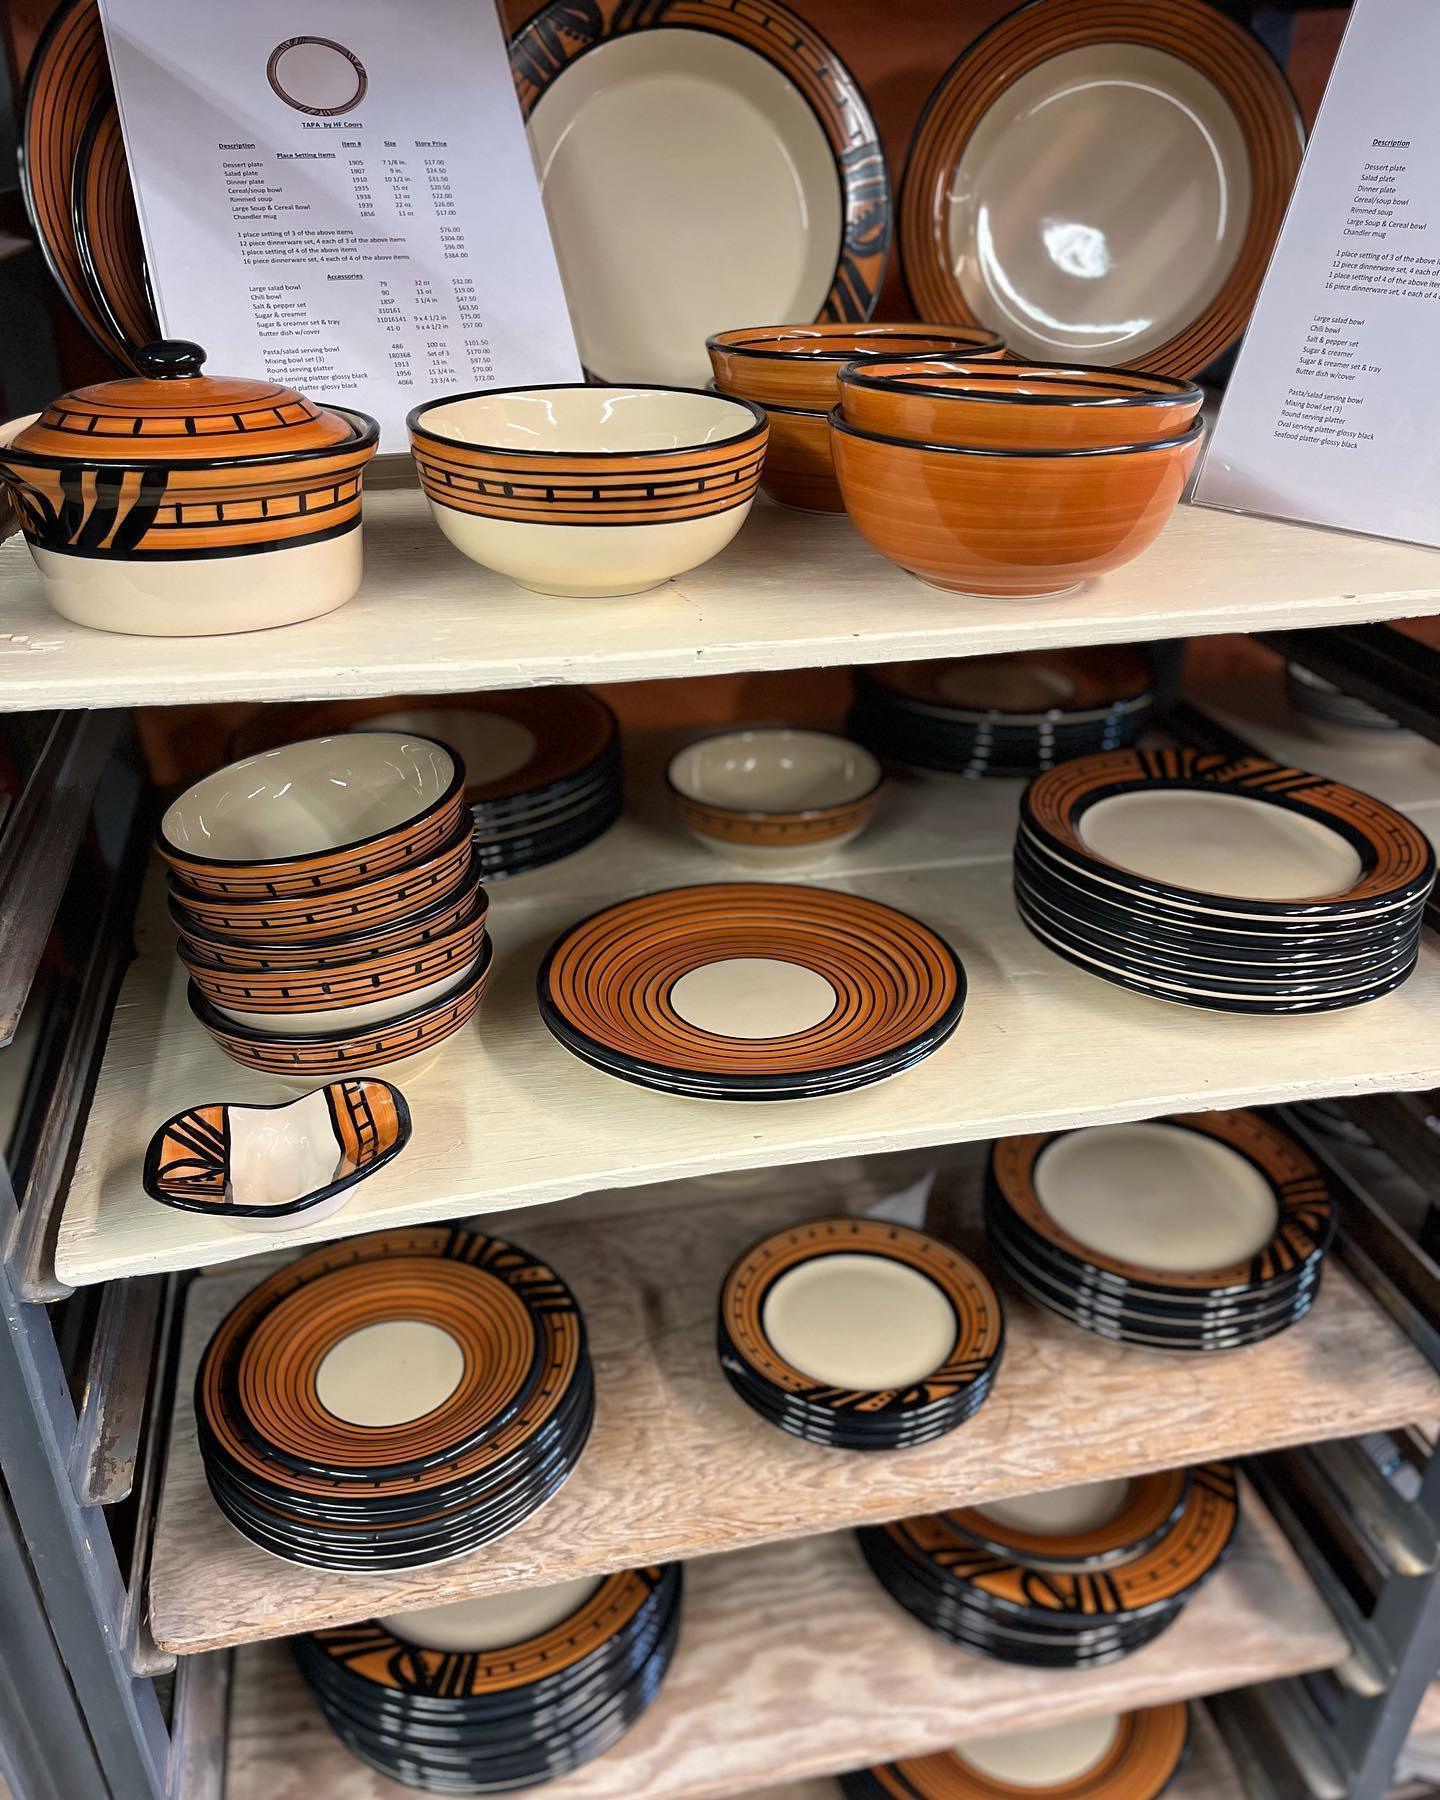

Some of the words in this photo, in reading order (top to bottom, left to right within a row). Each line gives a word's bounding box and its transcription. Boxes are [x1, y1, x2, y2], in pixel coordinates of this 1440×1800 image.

[323, 122, 332, 130] by
[218, 143, 256, 151] Description
[1372, 139, 1410, 148] Description
[294, 152, 318, 160] Setting
[1378, 175, 1395, 183] plate
[1353, 196, 1392, 205] Cereal/soup
[1350, 207, 1377, 215] Rimmed
[1346, 218, 1364, 226] Large
[1364, 220, 1381, 228] Soup
[1388, 221, 1410, 229] Cereal
[1409, 222, 1427, 230] bowl
[327, 273, 363, 281] Accessories
[1313, 315, 1331, 323] Large
[1348, 318, 1365, 326] bowl
[1302, 346, 1321, 354] Sugar
[1327, 350, 1354, 358] creamer
[313, 365, 334, 373] platter
[1298, 357, 1317, 365] Sugar
[1324, 361, 1351, 369] creamer
[1368, 365, 1382, 373] tray
[1330, 372, 1356, 380] w/cover
[1288, 389, 1324, 399] Pasta/salad
[1323, 395, 1347, 403] serving
[1347, 396, 1364, 404] bowl
[1284, 399, 1306, 409] Mixing
[1306, 402, 1322, 410] bowl
[1280, 410, 1302, 418] Round
[1301, 414, 1325, 422] serving
[1324, 416, 1346, 424] platter
[1277, 420, 1292, 428] Oval
[1291, 424, 1315, 432] serving
[1357, 432, 1375, 440] black
[1273, 431, 1299, 440] Seafood
[1341, 440, 1358, 449] black
